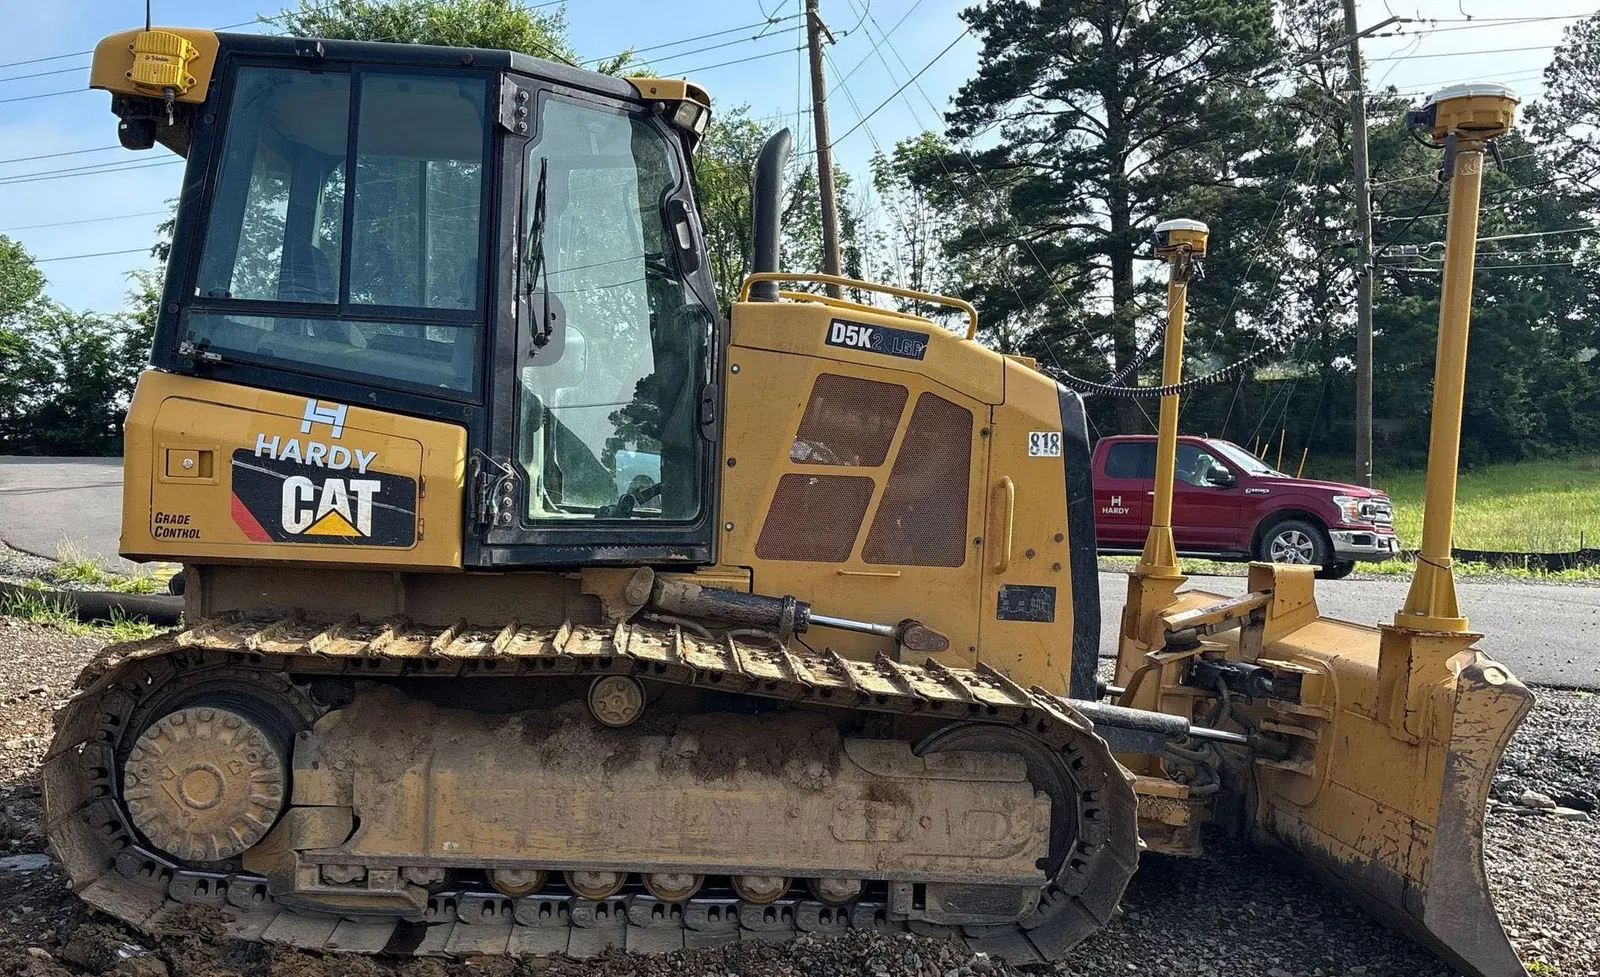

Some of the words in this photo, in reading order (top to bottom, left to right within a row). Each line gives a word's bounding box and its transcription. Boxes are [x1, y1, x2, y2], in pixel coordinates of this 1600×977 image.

[254, 432, 378, 474] HARDY
[1030, 432, 1060, 456] 818
[281, 475, 381, 537] CAT
[1102, 506, 1130, 515] HARDY
[154, 511, 192, 525] GRADE
[154, 525, 202, 539] CONTROL
